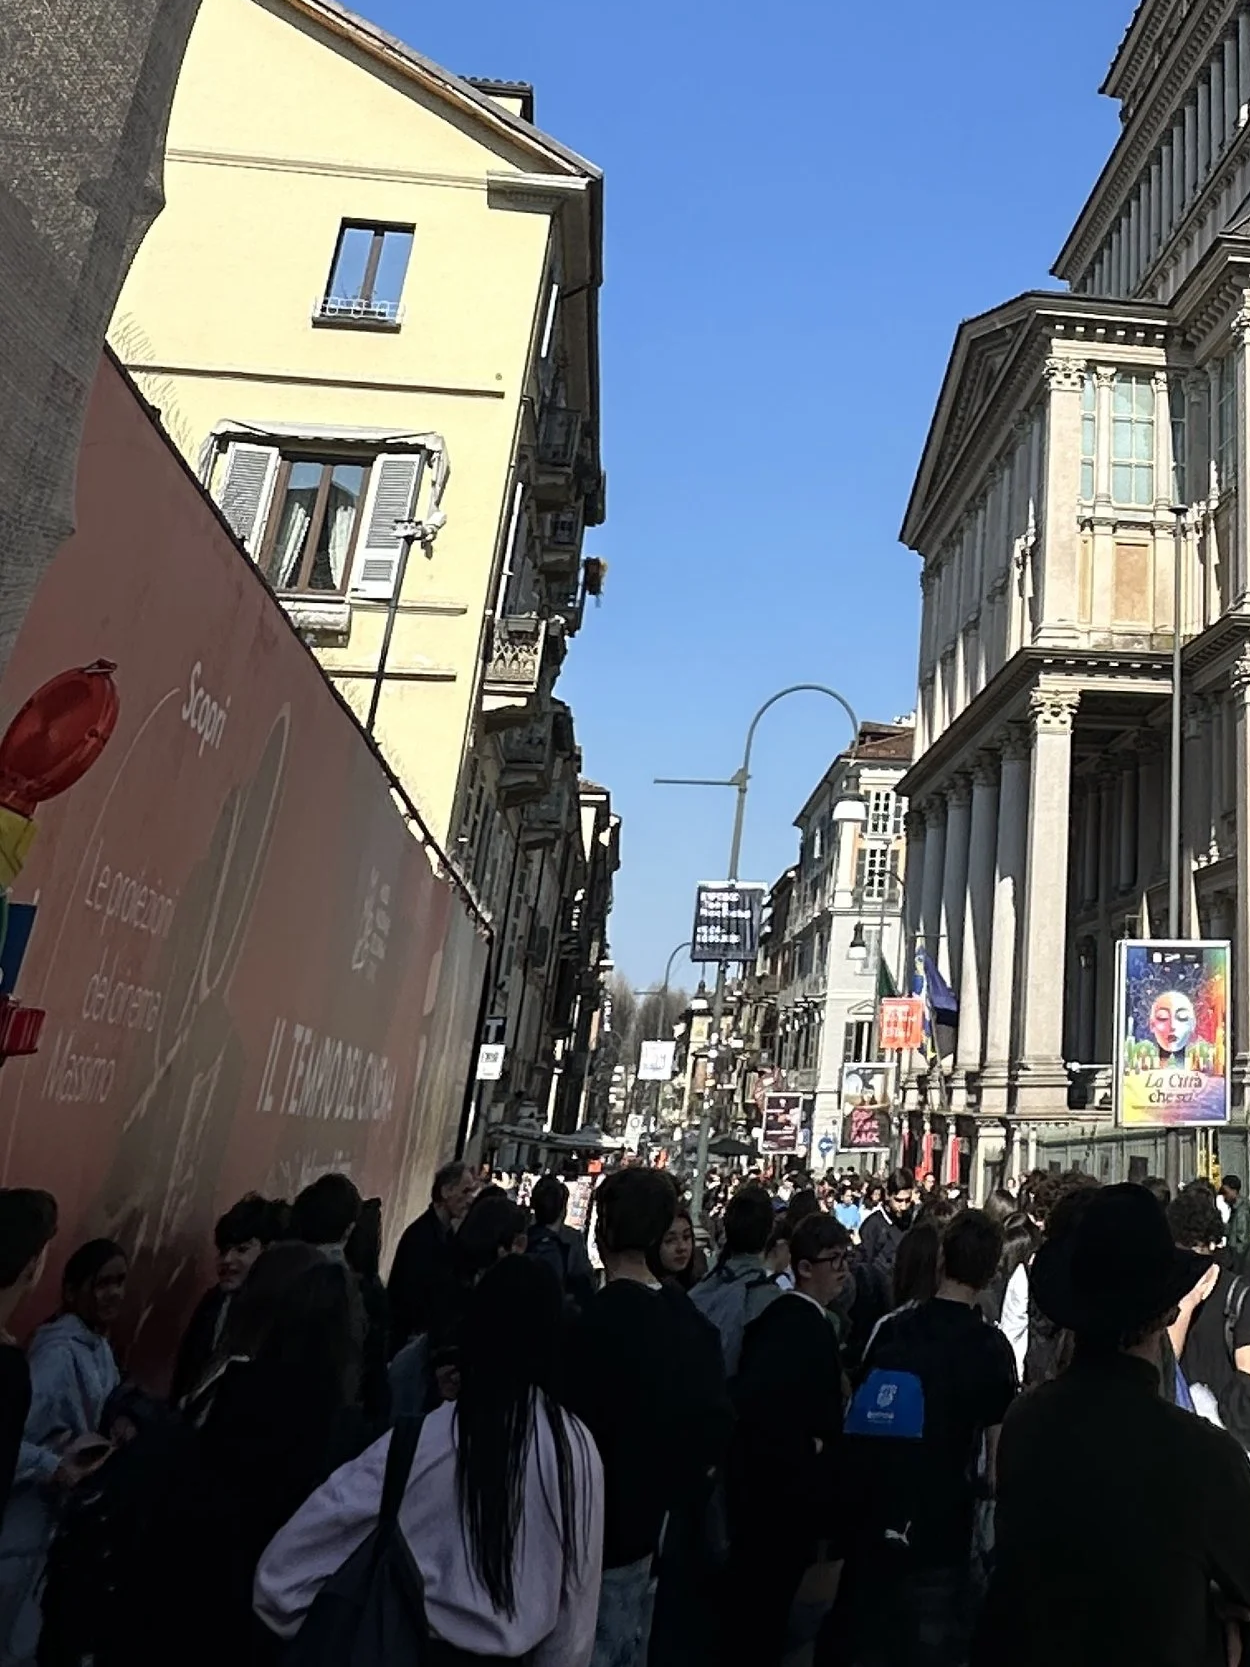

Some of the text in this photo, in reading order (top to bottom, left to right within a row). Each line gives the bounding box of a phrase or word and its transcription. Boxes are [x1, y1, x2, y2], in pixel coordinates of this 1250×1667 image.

[182, 660, 231, 758] Scopri
[85, 837, 111, 911] Le
[83, 945, 120, 1021] del
[41, 1028, 116, 1103] Massimo
[256, 1016, 287, 1112] IL
[279, 1023, 343, 1120] TEMPIO
[1145, 1074, 1164, 1088] La
[1148, 1089, 1173, 1103] che
